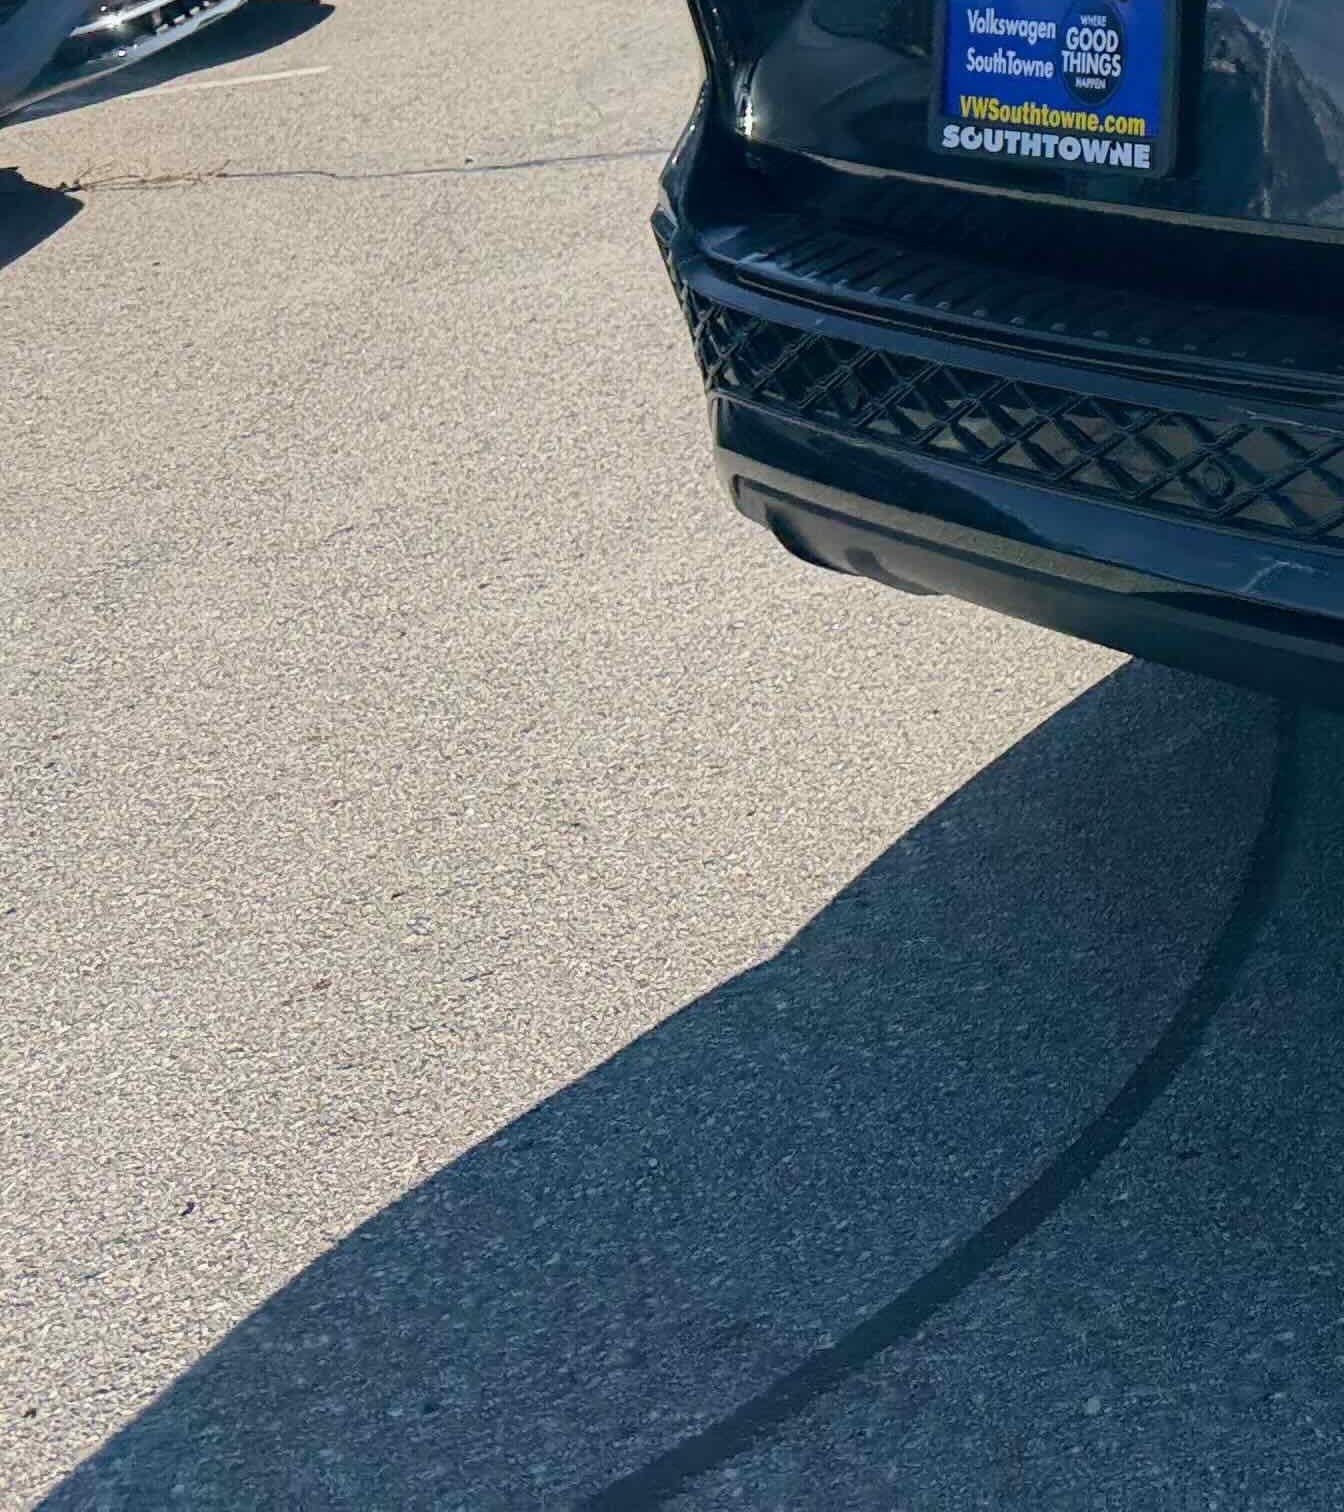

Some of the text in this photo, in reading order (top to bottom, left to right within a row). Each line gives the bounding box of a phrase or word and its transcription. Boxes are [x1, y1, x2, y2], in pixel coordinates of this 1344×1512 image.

[967, 8, 1057, 45] Volkswagen
[1066, 26, 1119, 53] GOOD
[966, 47, 1055, 78] SouthTowne
[1061, 50, 1121, 77] THINGS
[960, 95, 1146, 136] VWSouthtowne.com
[942, 124, 1151, 169] SOUTHTOWNE
